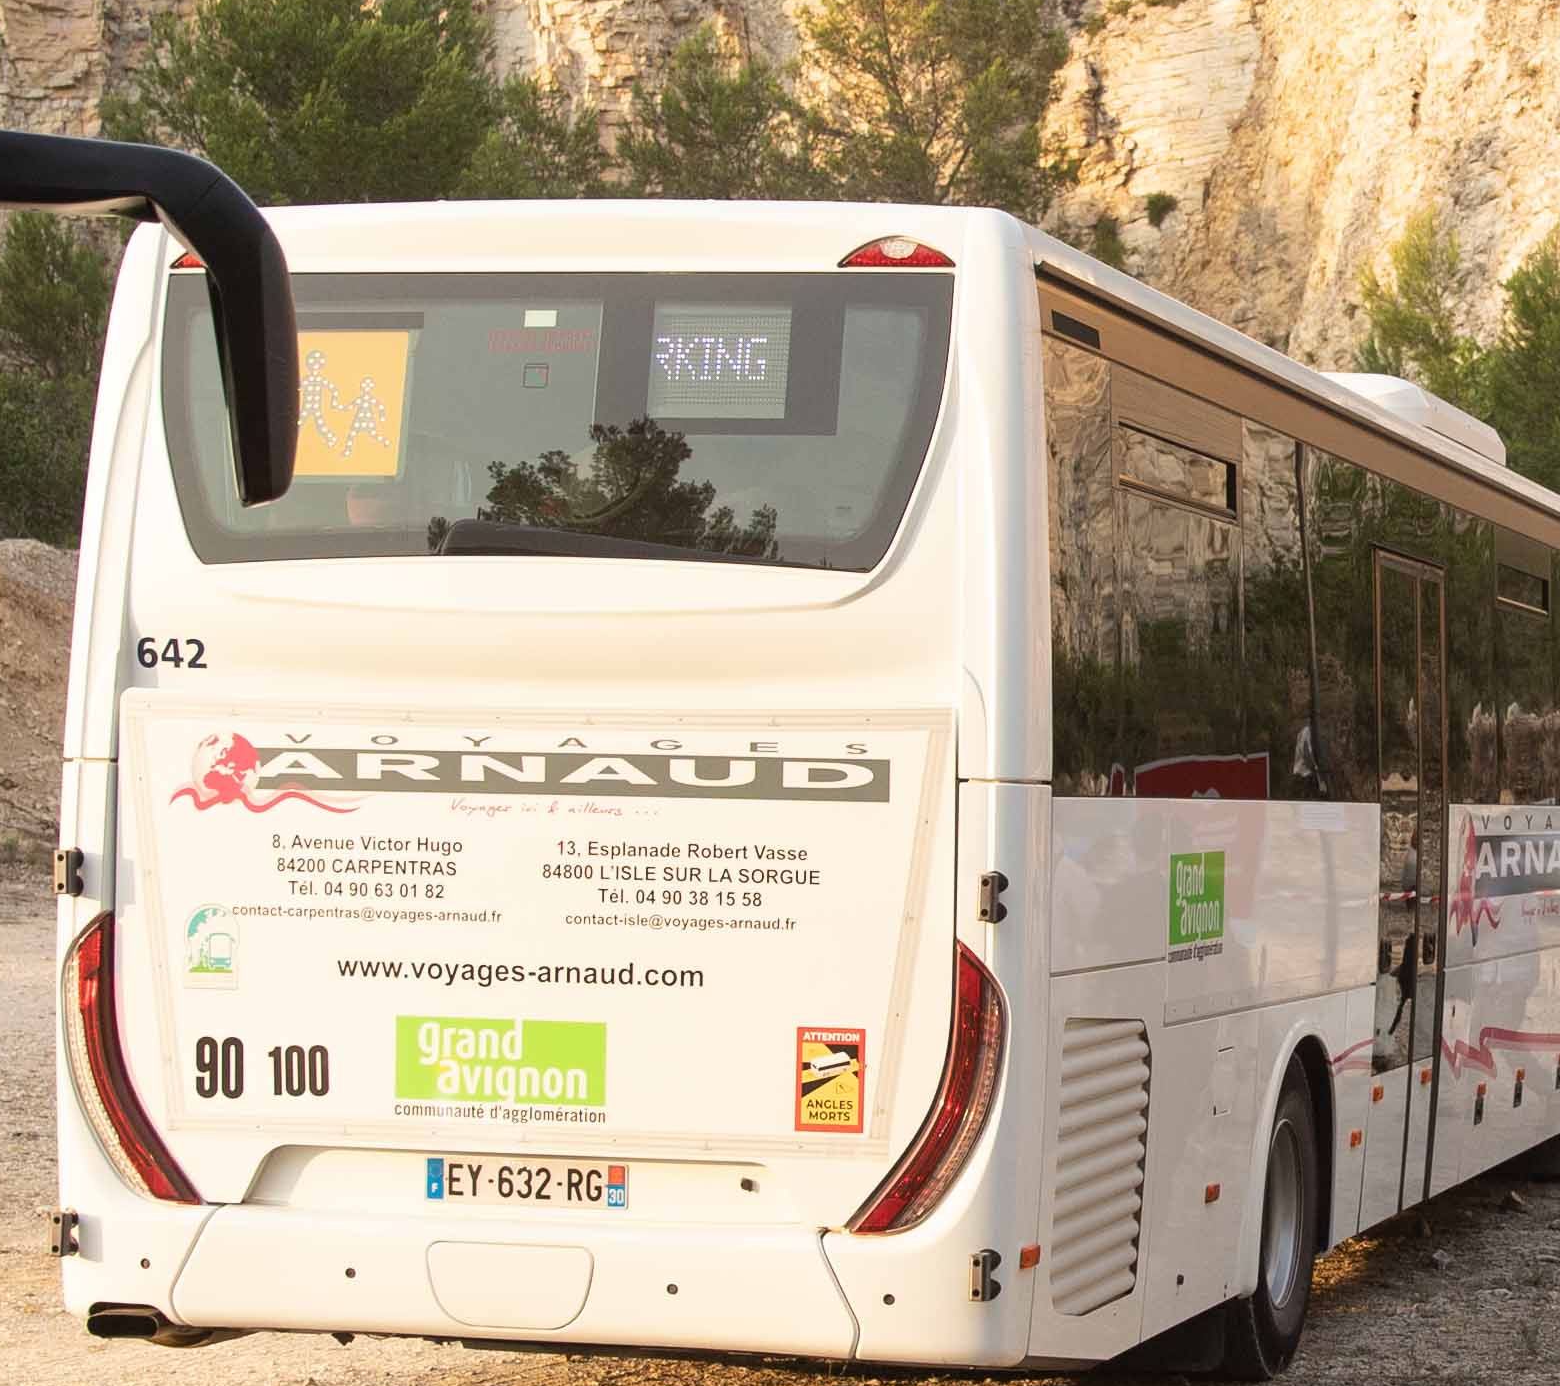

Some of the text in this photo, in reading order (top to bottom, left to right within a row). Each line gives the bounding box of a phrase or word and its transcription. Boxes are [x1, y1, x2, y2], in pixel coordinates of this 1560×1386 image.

[137, 637, 207, 668] 642
[285, 734, 868, 755] VOYAGES
[256, 751, 874, 789] ARNAUD
[291, 835, 354, 851] Avenue
[361, 836, 411, 852] Victor
[417, 837, 463, 856] Hugo
[588, 841, 681, 860] Esplanade
[688, 844, 748, 860] Robert
[754, 845, 808, 861] Vasse
[276, 857, 457, 876] 84200 CARPENTRAS
[542, 864, 593, 880] 84800
[664, 867, 701, 883] SUR
[708, 868, 732, 883] LA
[738, 869, 821, 885] SORGUE
[289, 880, 445, 899] Tél. 04 90 63 01 82
[1176, 853, 1204, 906] grand
[598, 888, 762, 907] Tél. 04 90 38 15 58
[232, 904, 502, 923] contact-carpentras@voyages-arnaud.fr
[565, 913, 797, 931] contact-isle@voyages-arnaud.fr
[337, 959, 704, 987] www.voyages-arnaud.com
[417, 1017, 523, 1065] grand
[803, 1031, 860, 1042] ATTENTION
[196, 1036, 329, 1099] 90 100
[436, 1059, 588, 1101] avignon
[394, 1102, 606, 1124] communauté d'agglomération
[806, 1099, 853, 1110] ANGLES
[808, 1110, 850, 1121] MORTS
[609, 1188, 625, 1204] 30
